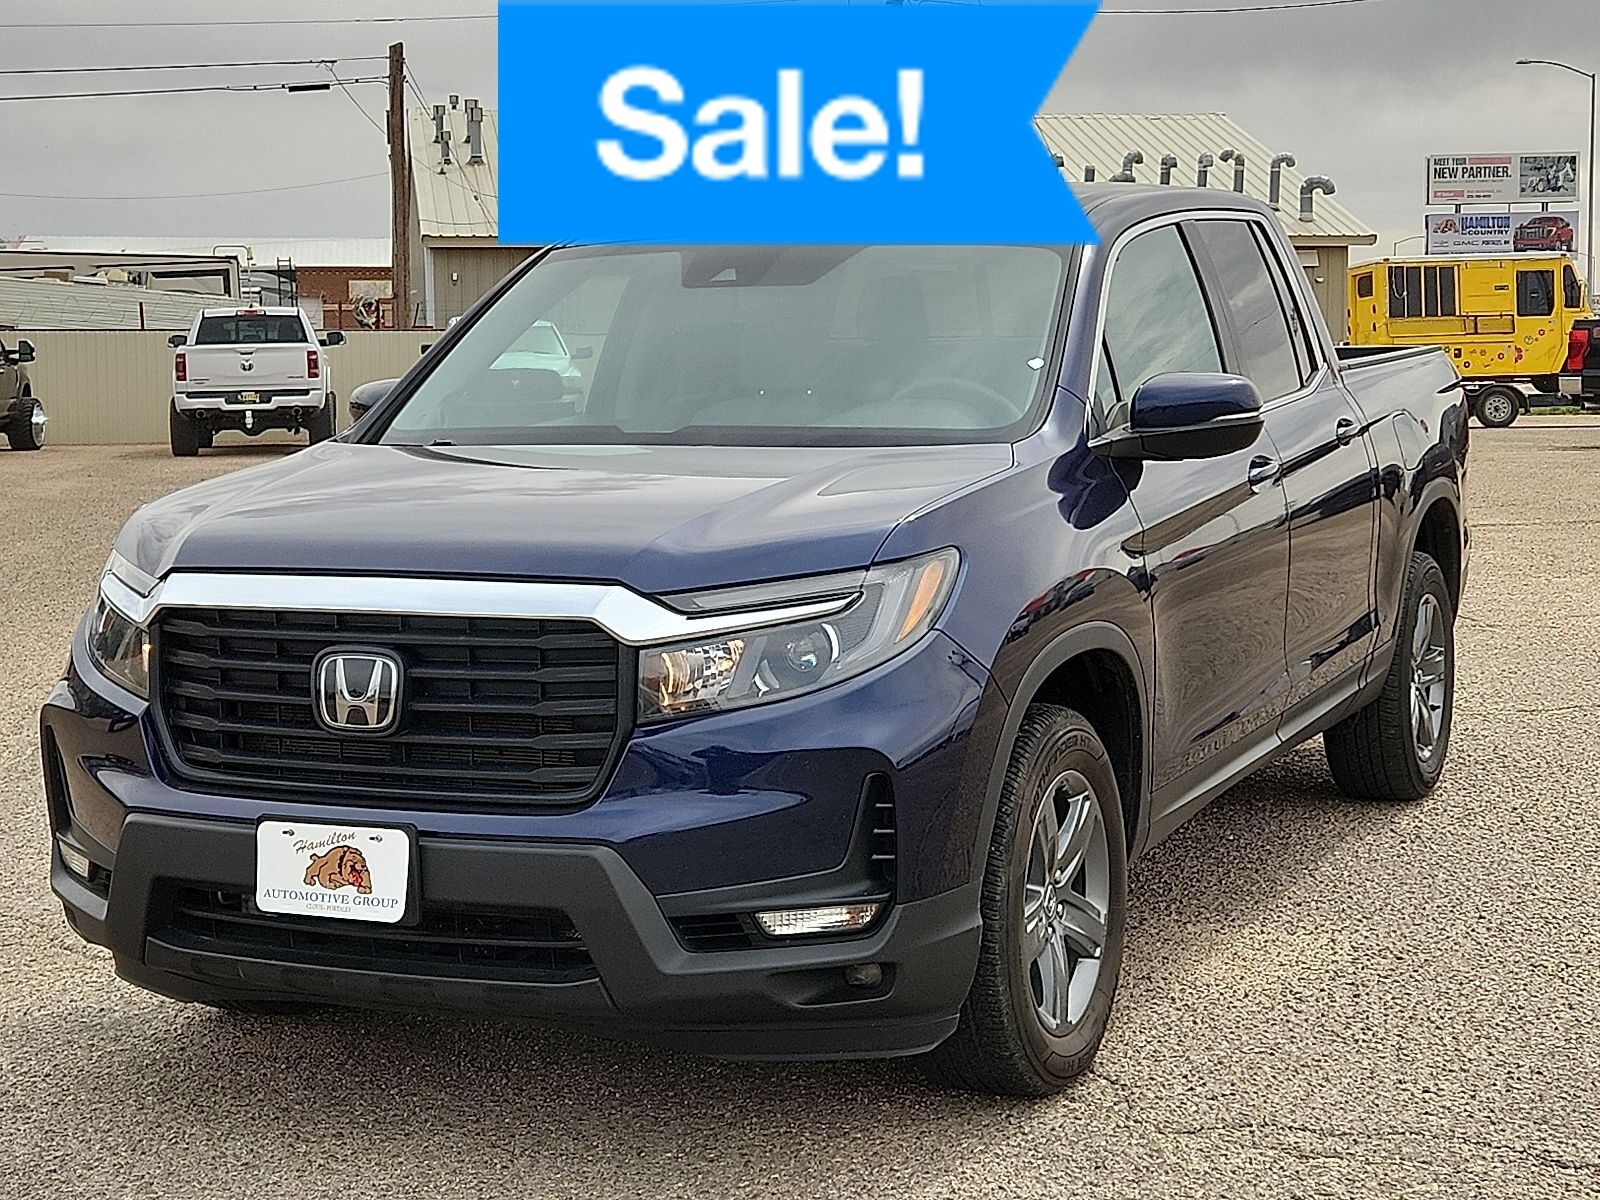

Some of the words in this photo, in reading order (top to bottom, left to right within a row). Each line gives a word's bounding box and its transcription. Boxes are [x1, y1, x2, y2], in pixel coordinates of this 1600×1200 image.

[1433, 157, 1450, 166] MEET
[1433, 167, 1458, 179] NEW
[1461, 166, 1512, 179] PARTNER.
[1460, 216, 1510, 230] HAMILTON
[293, 831, 357, 854] Hamilton
[263, 888, 350, 905] AUTOMOTIVE
[352, 895, 399, 909] GROUP
